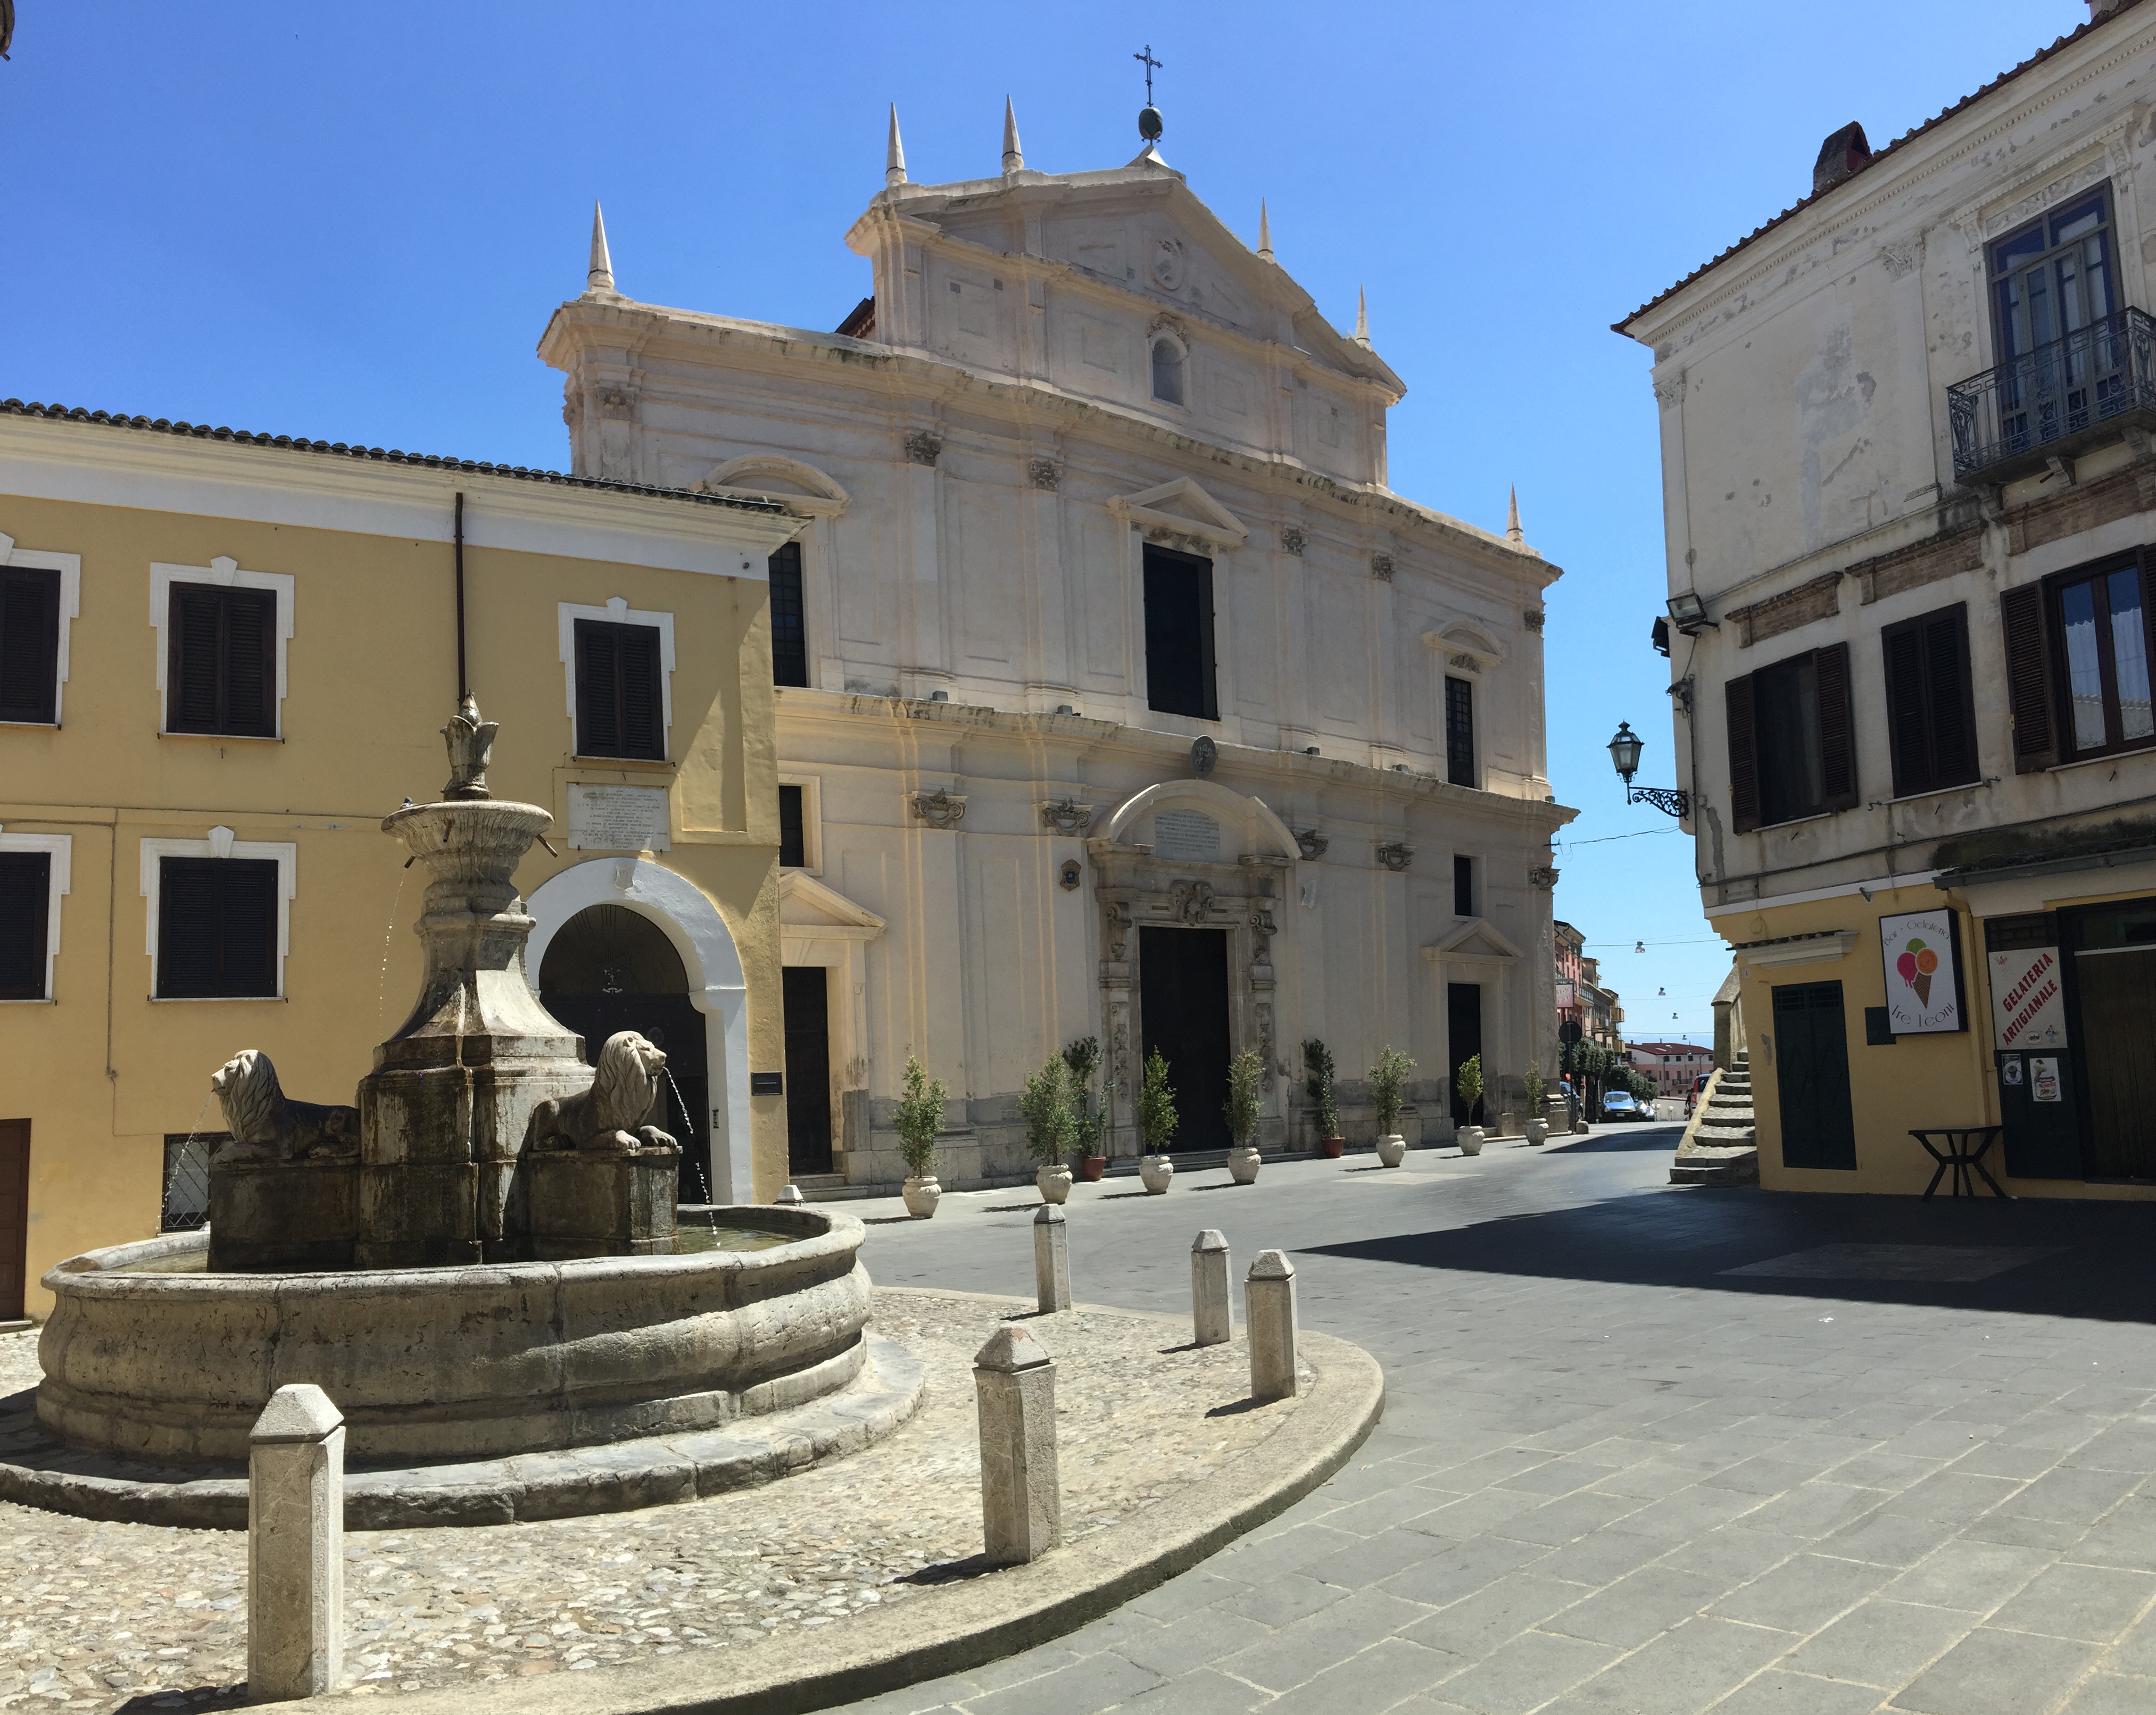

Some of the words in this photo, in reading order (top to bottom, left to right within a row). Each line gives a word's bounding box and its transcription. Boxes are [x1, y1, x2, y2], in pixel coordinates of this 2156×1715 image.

[1882, 931, 1897, 946] Bar
[1907, 920, 1950, 940] Gelateria
[2002, 953, 2053, 1012] GELATERIA
[2002, 979, 2058, 1046] ARTIGIANALE
